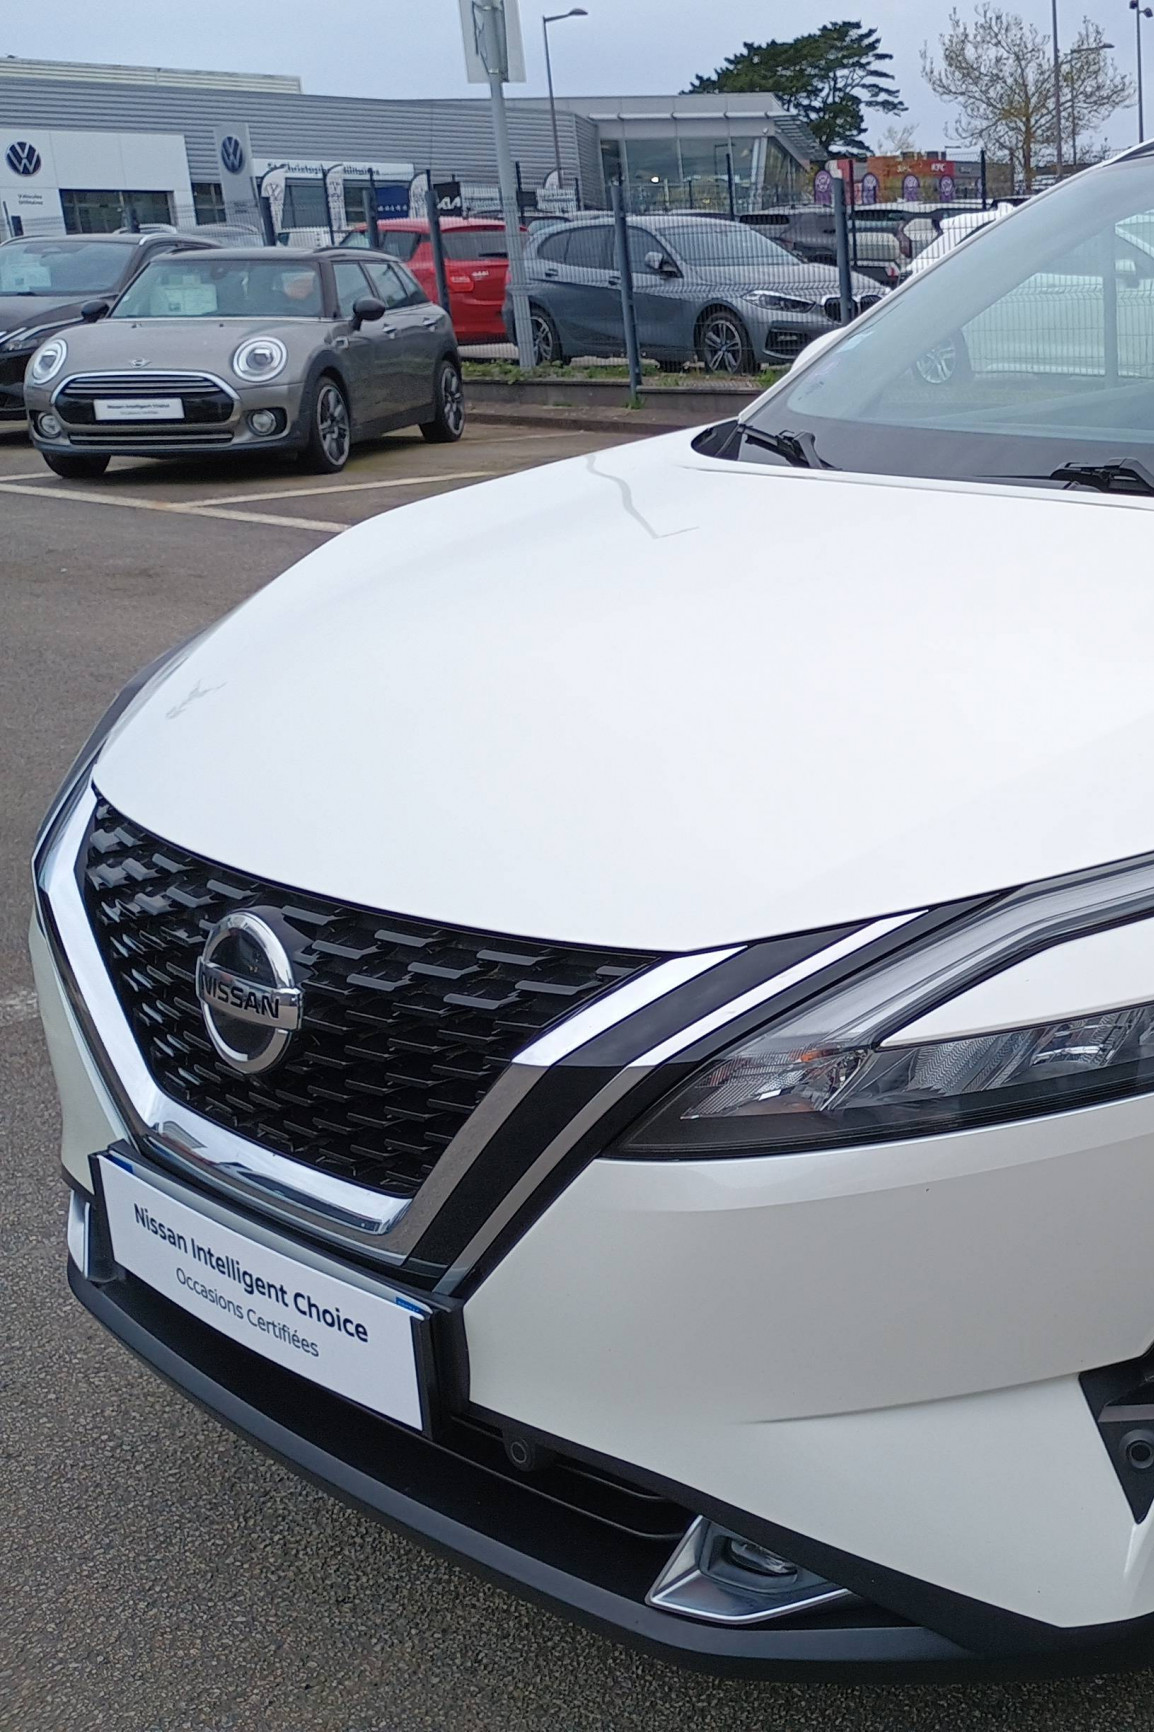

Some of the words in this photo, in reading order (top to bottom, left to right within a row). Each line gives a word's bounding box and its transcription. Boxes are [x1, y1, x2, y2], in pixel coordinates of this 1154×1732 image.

[202, 972, 280, 1019] NISSAN
[133, 1203, 188, 1254] Nissan
[190, 1237, 290, 1308] Intelligent
[293, 1291, 369, 1344] Choice
[176, 1267, 244, 1320] Occasions
[247, 1308, 320, 1358] Certifiées
